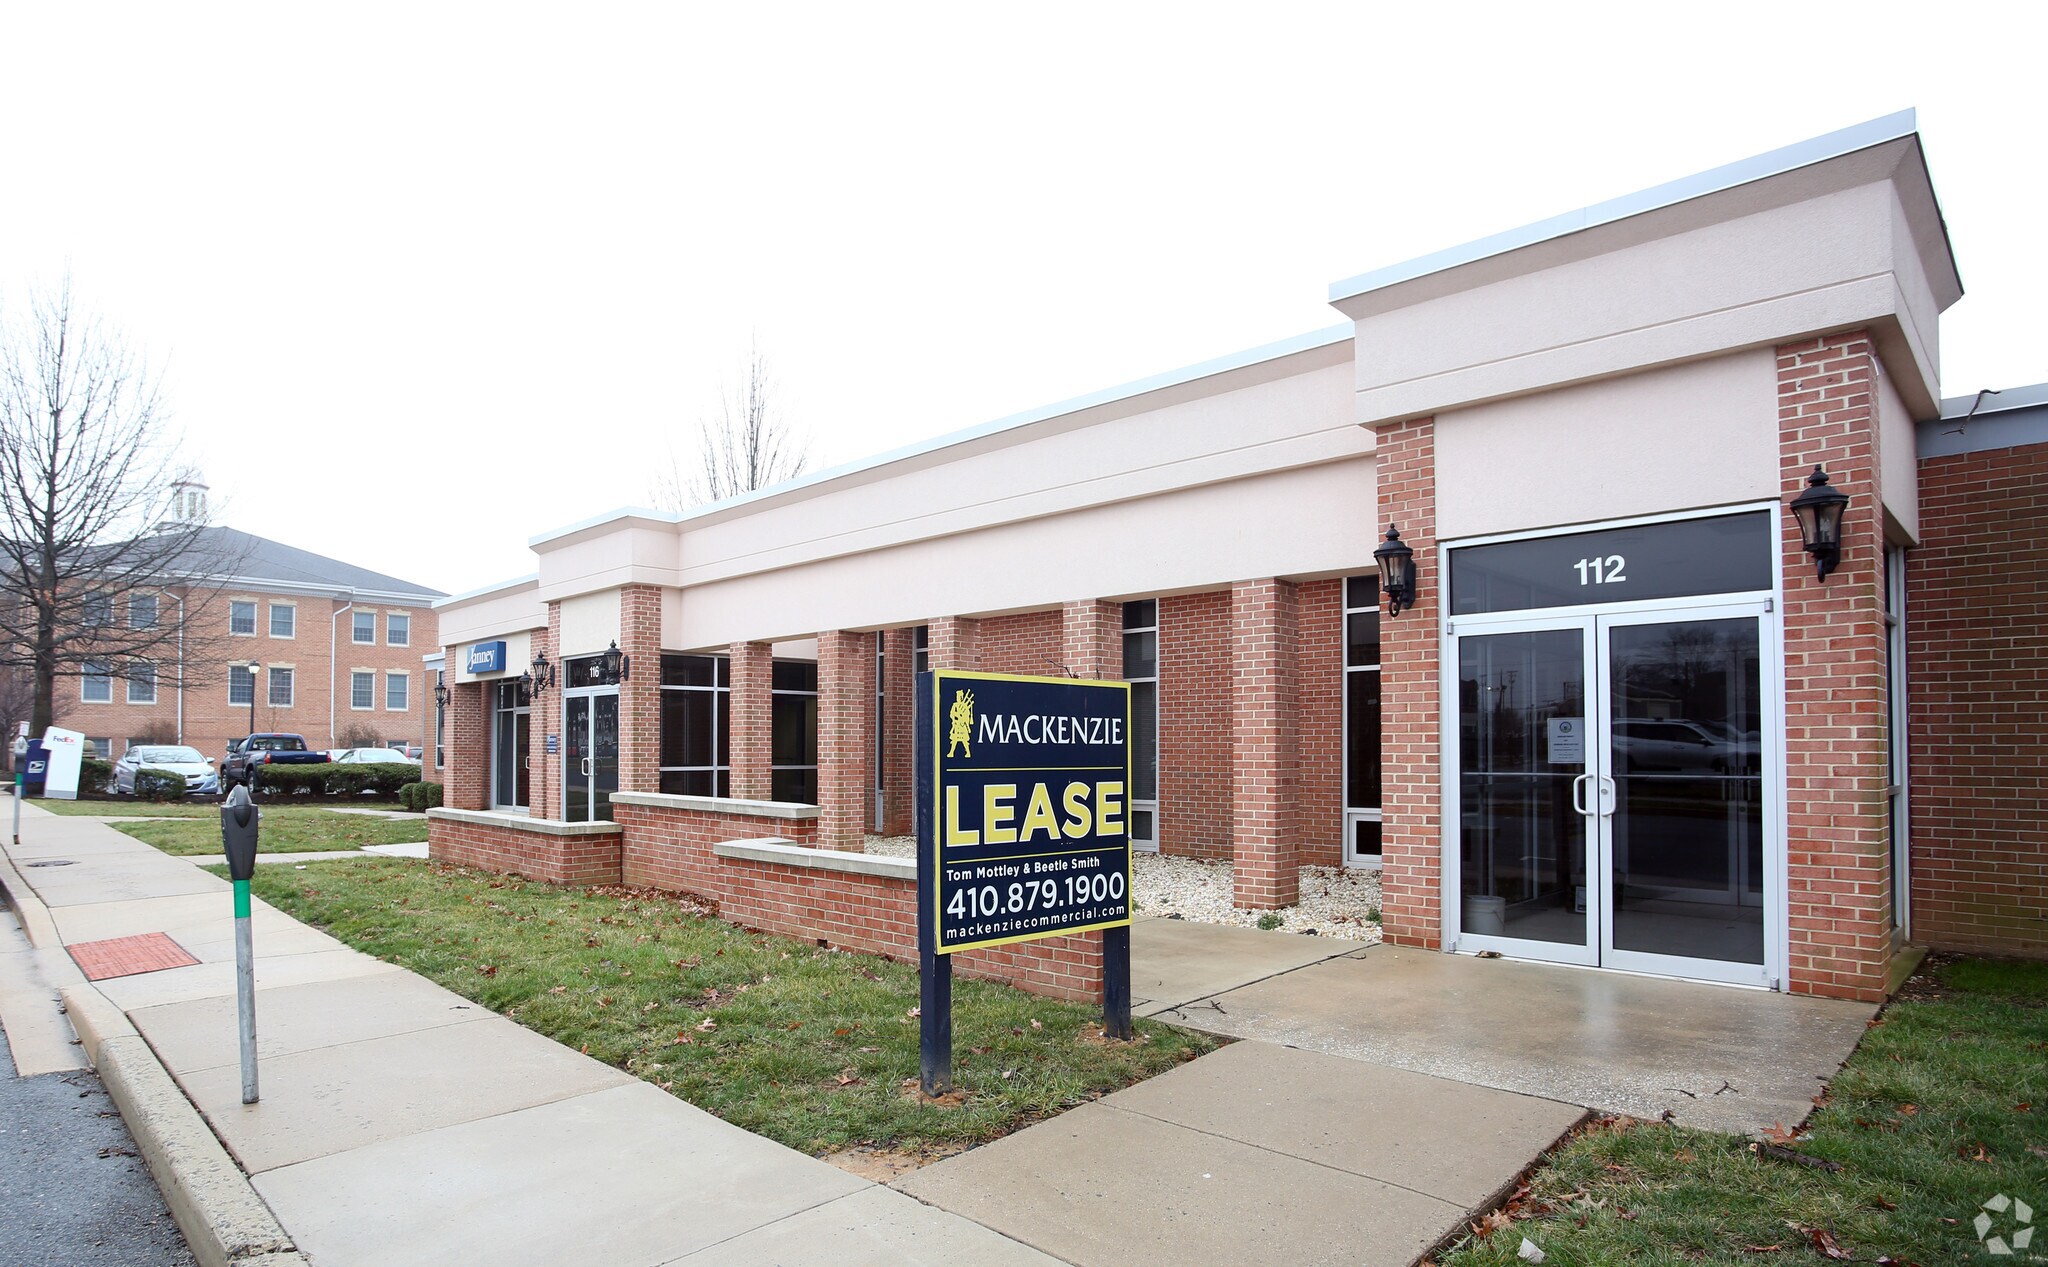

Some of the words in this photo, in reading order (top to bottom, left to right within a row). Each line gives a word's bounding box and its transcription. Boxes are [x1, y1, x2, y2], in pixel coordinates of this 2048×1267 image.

[1573, 554, 1627, 586] 112
[468, 645, 495, 670] Janney
[589, 665, 600, 678] 116
[53, 735, 75, 743] FedEx
[977, 713, 1124, 745] MACKENZIE
[946, 781, 1124, 848] LEASE
[946, 869, 972, 882] Tom
[976, 866, 1020, 879] Mottley
[1023, 863, 1031, 874] &
[1034, 858, 1068, 873] Beetle
[1071, 856, 1100, 870] Smith
[946, 871, 1125, 920] 410.879.1900
[946, 904, 1125, 940] mackenziecommercial.com
